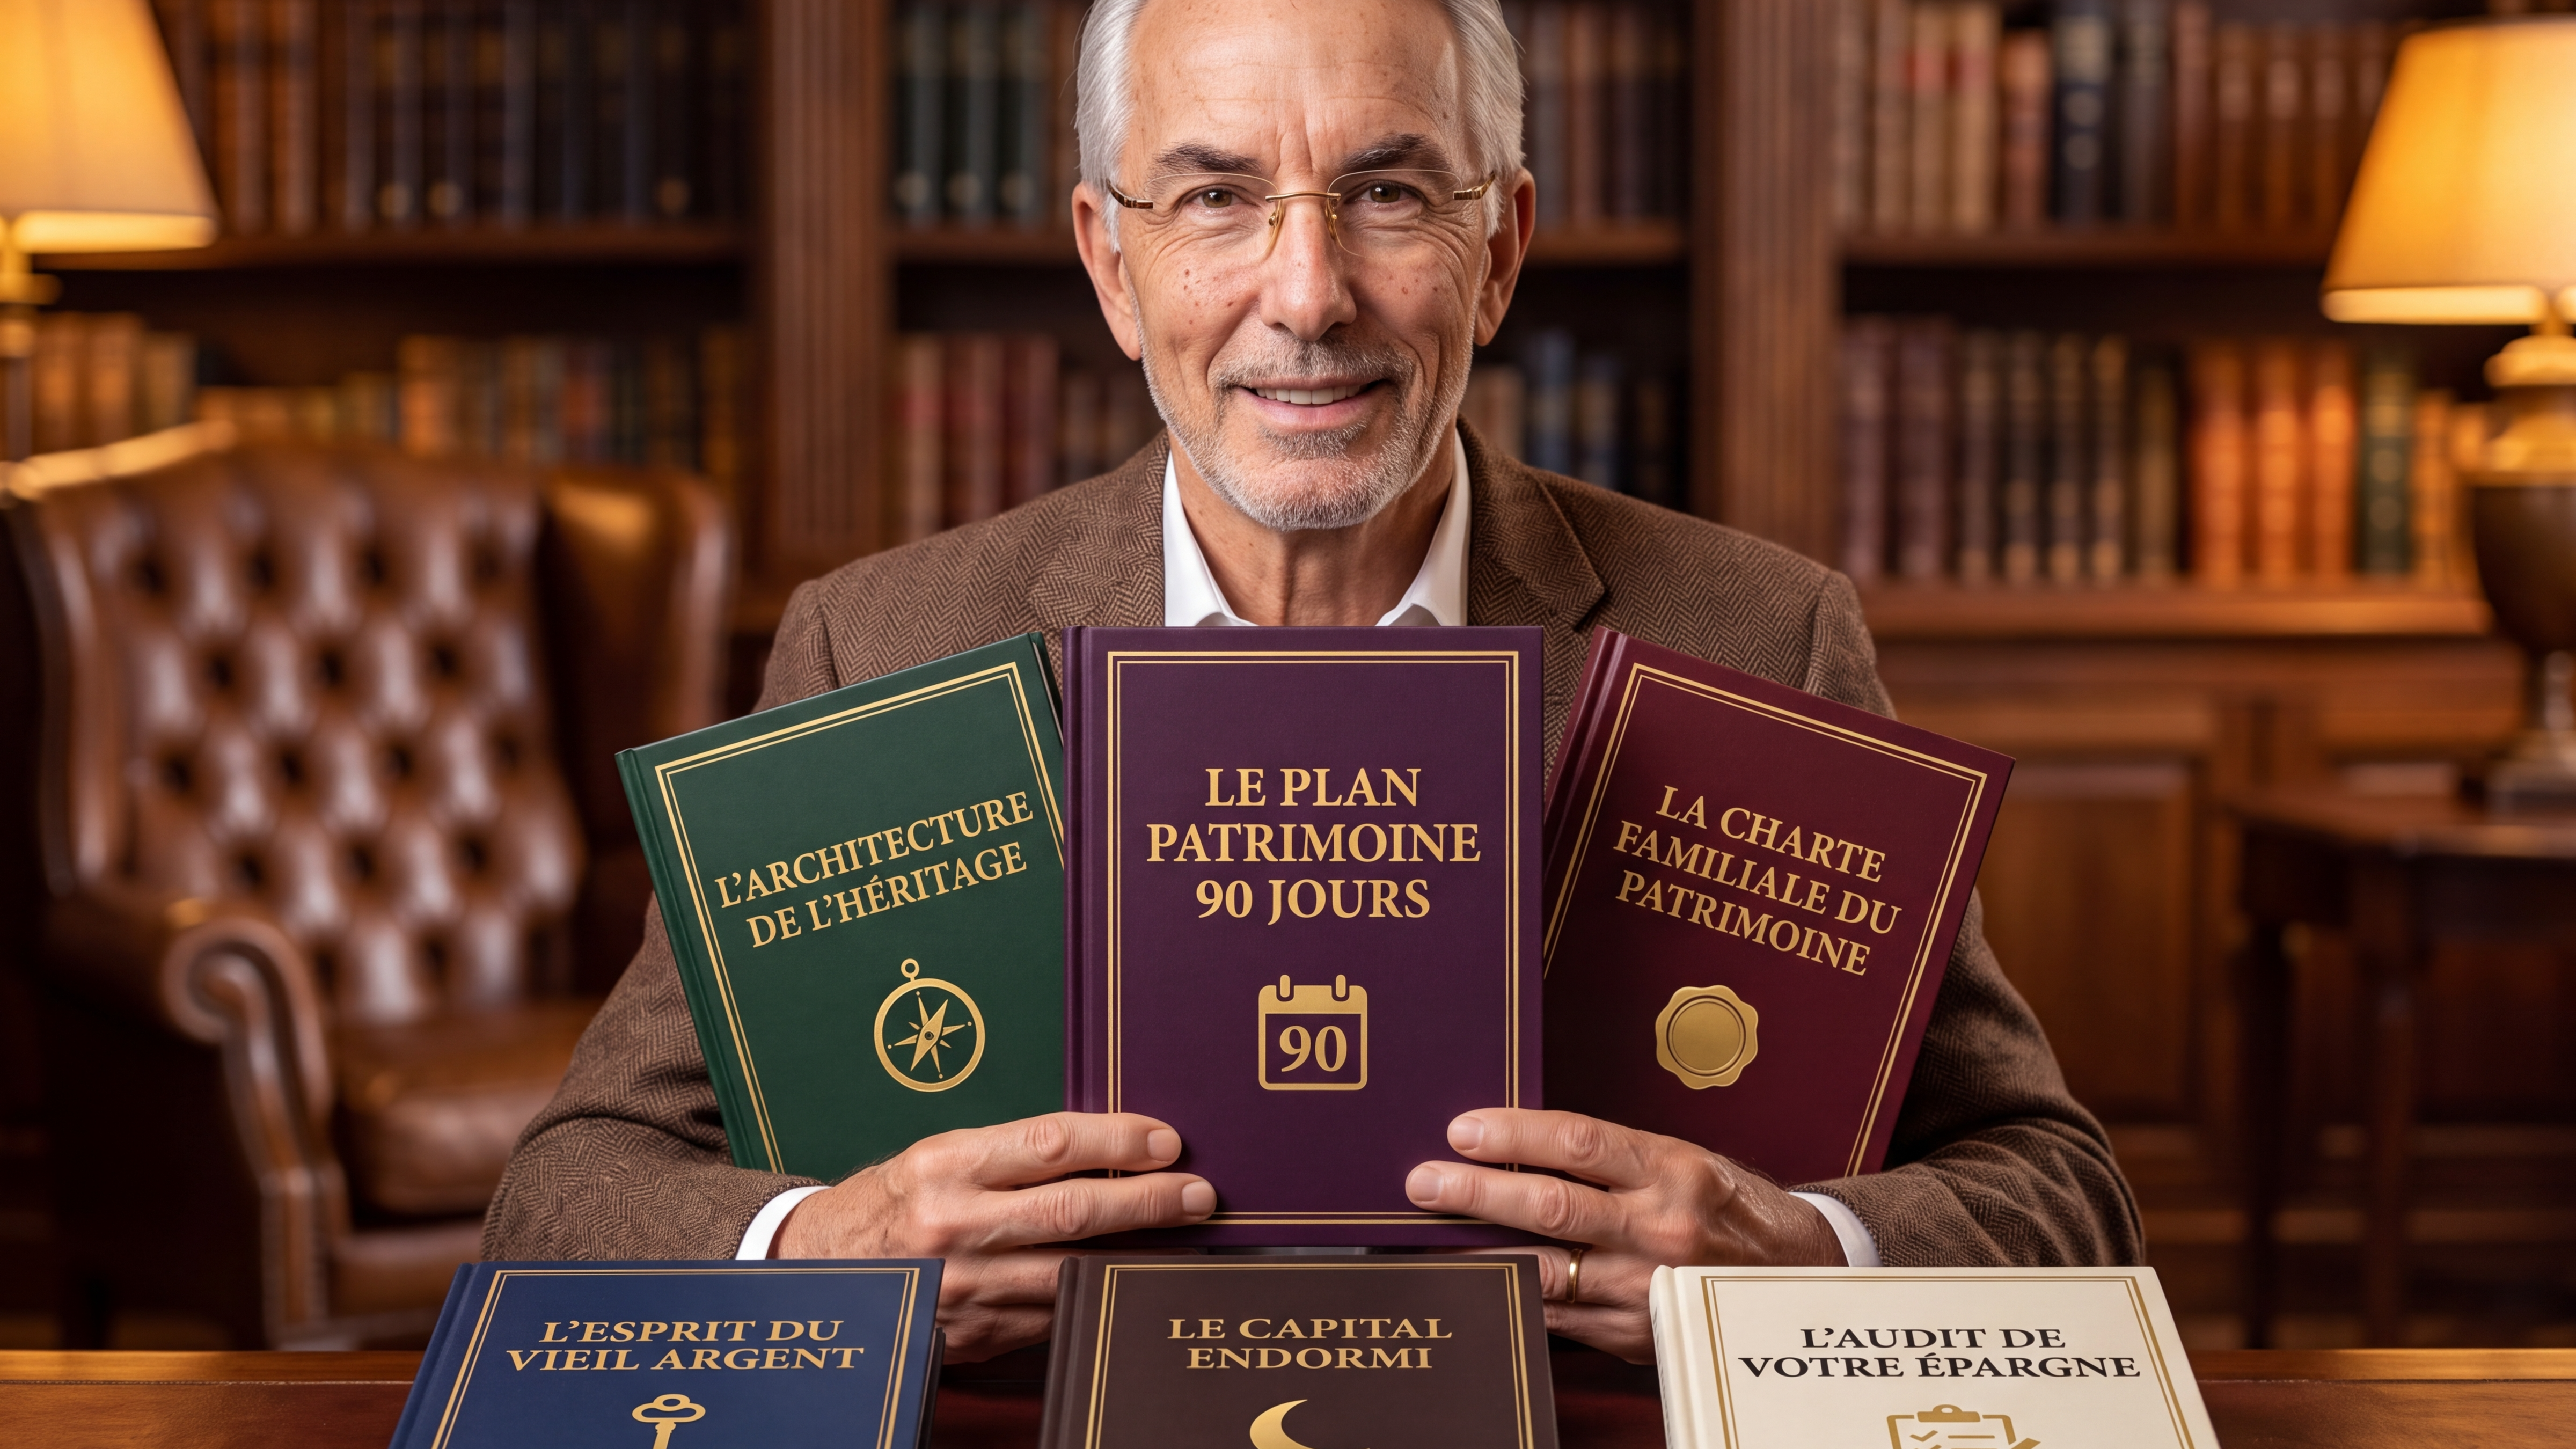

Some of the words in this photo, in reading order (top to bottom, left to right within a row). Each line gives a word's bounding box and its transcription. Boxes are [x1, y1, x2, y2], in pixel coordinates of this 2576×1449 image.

[1205, 768, 1266, 806] LE
[1280, 767, 1422, 807] PLAN
[714, 791, 1034, 909] L’ARCHITECTURE
[1146, 823, 1481, 862] PATRIMOINE
[1656, 785, 1707, 829] LA
[1720, 807, 1885, 883] CHARTE
[745, 906, 801, 948] DE
[804, 841, 1027, 932] L’HÉRITAGE
[1613, 821, 1830, 914] FAMILIALE
[1834, 890, 1902, 934] DU
[1196, 880, 1253, 918] 90
[1268, 879, 1430, 925] JOURS
[1615, 870, 1870, 976] PATRIMOINE
[1279, 1026, 1347, 1072] 90
[538, 1320, 756, 1343] L’ESPRIT
[765, 1320, 844, 1341] DU
[1167, 1319, 1226, 1339] LE
[1239, 1318, 1452, 1339] CAPITAL
[1800, 1328, 1987, 1349] L’AUDIT
[1998, 1328, 2066, 1348] DE
[506, 1349, 640, 1371] VIEIL
[650, 1347, 865, 1370] ARGENT
[1186, 1348, 1432, 1369] ENDORMI
[1738, 1357, 1905, 1378] VOTRE
[1914, 1352, 2141, 1378] ÉPARGNE
